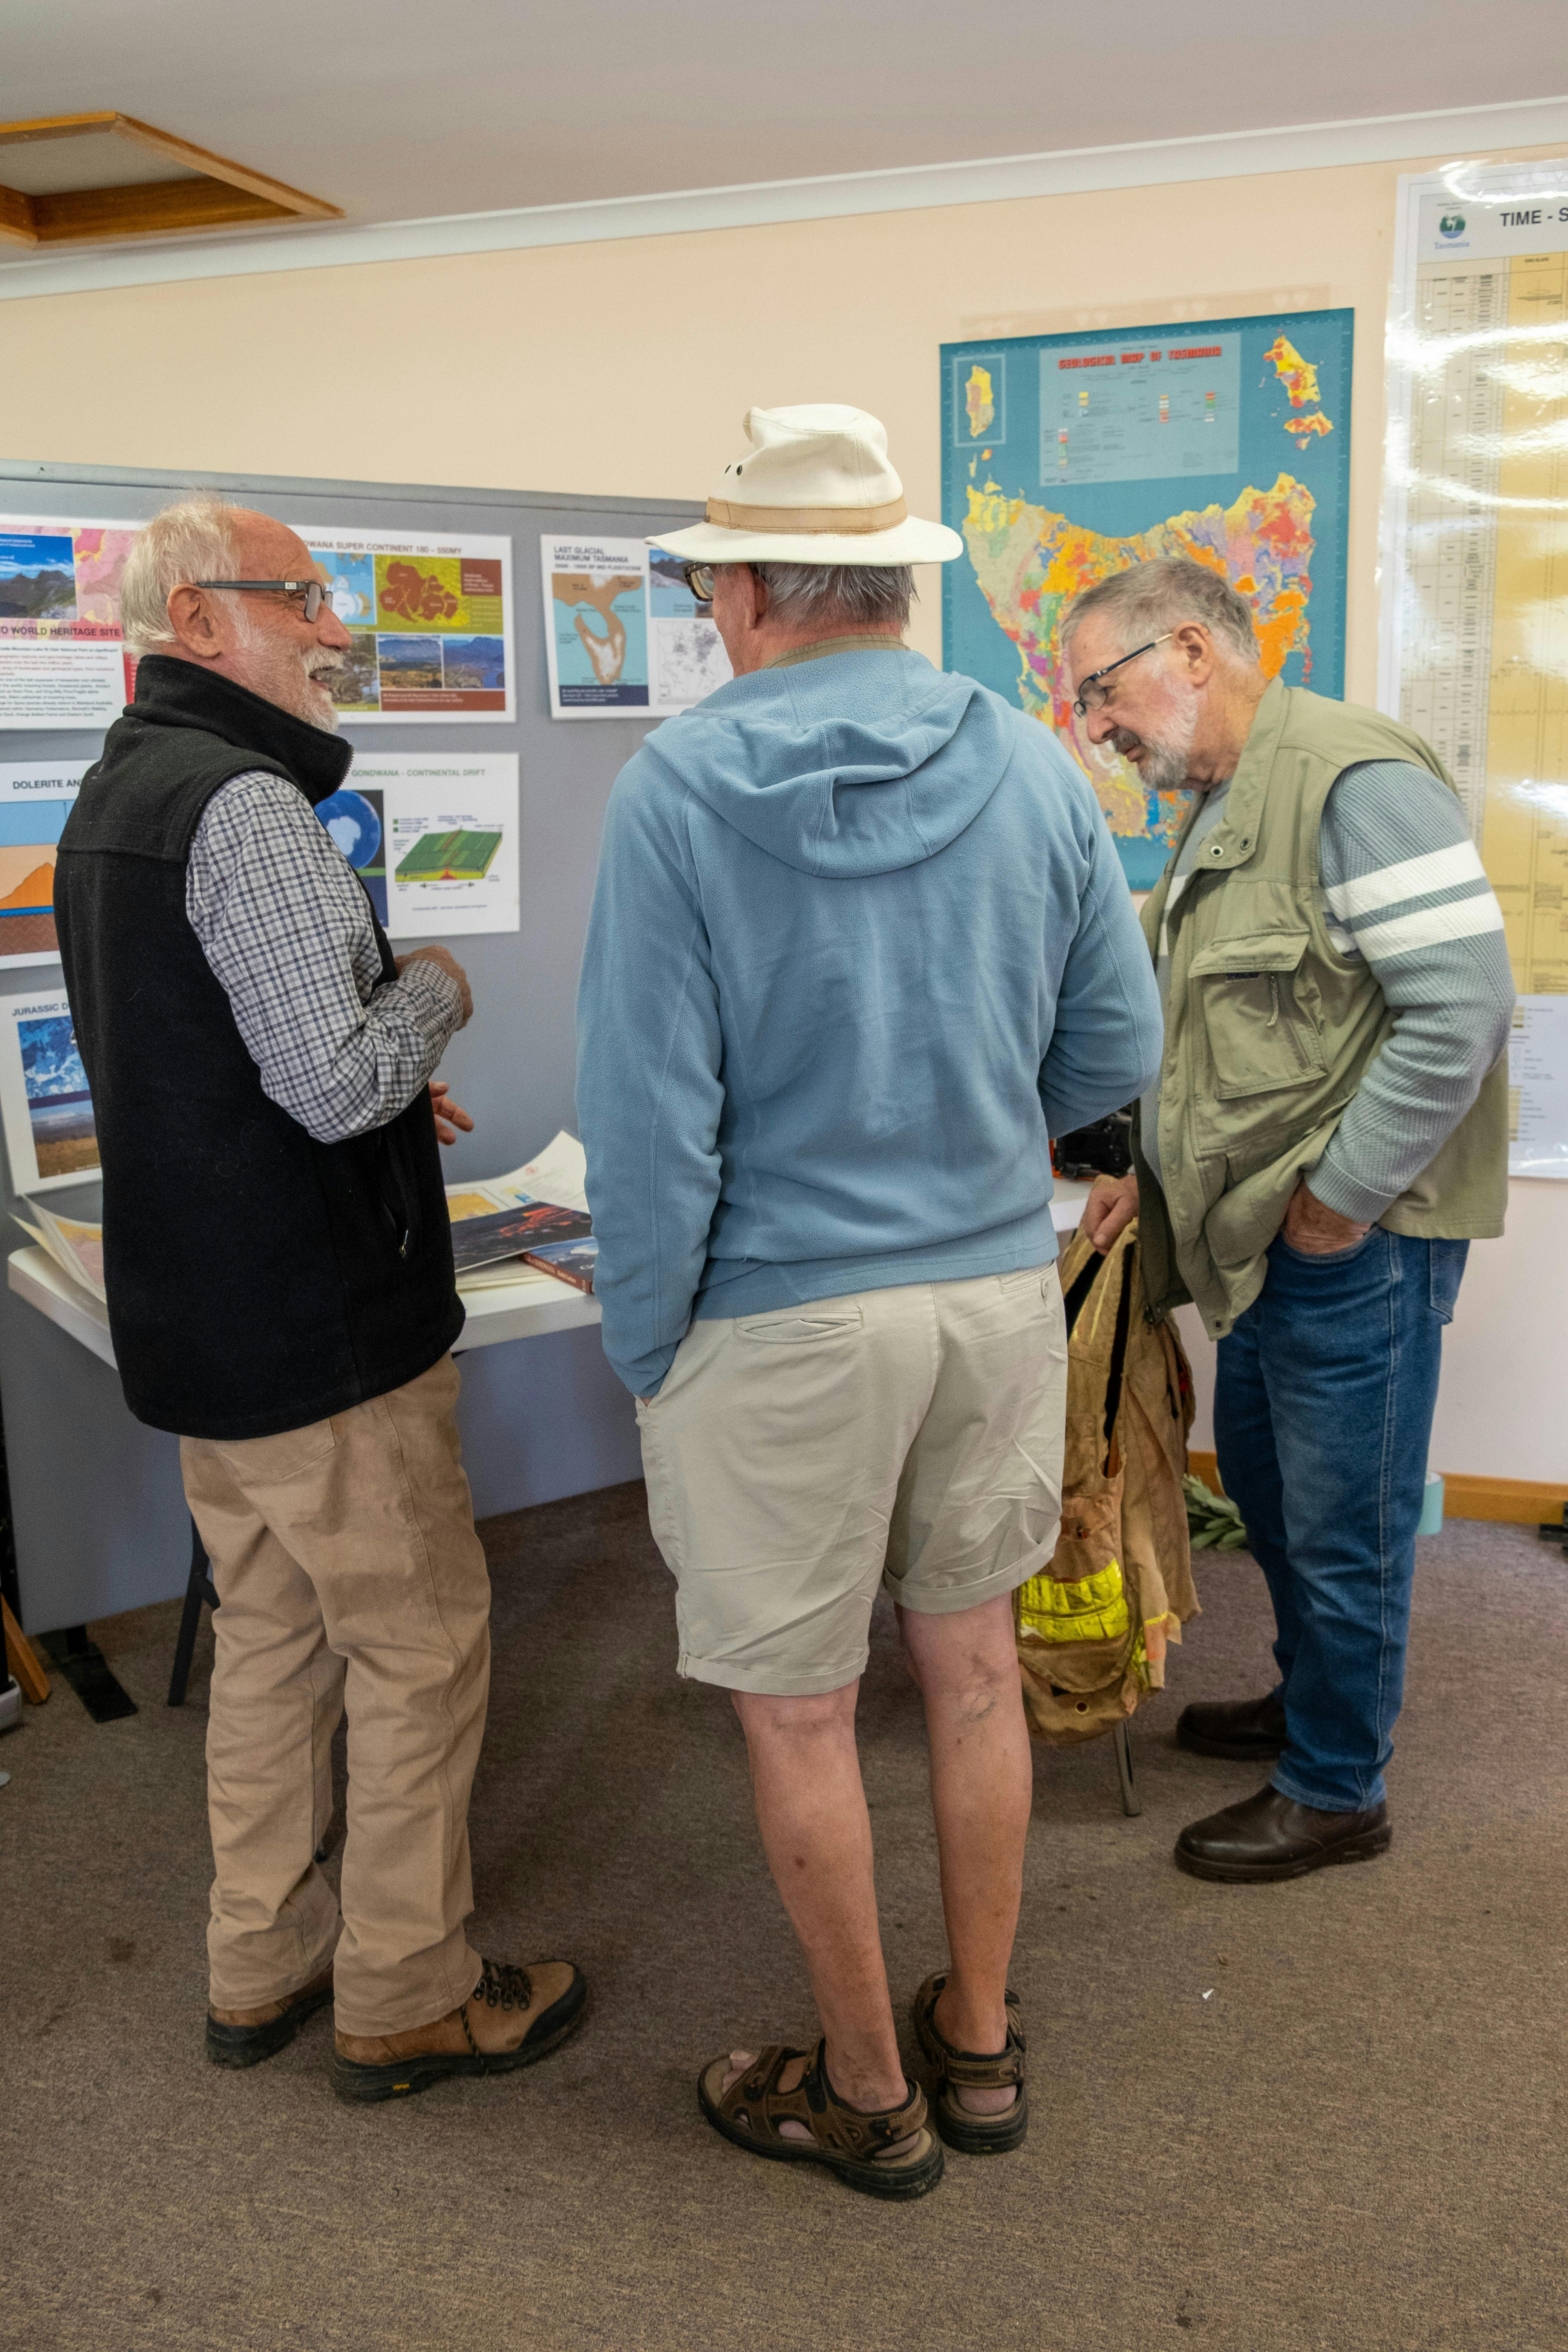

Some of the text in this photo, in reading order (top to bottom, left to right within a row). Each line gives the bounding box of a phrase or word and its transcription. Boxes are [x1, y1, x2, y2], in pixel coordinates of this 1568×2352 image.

[1499, 210, 1542, 227] TIME
[336, 542, 364, 550] SUPER
[367, 544, 413, 553] CONTINENT
[11, 627, 47, 635] WORLD
[50, 627, 97, 636] HERITAGE
[100, 628, 120, 637] SITE
[13, 780, 63, 789] DOLERITE
[12, 1003, 59, 1016] JURASSIC
